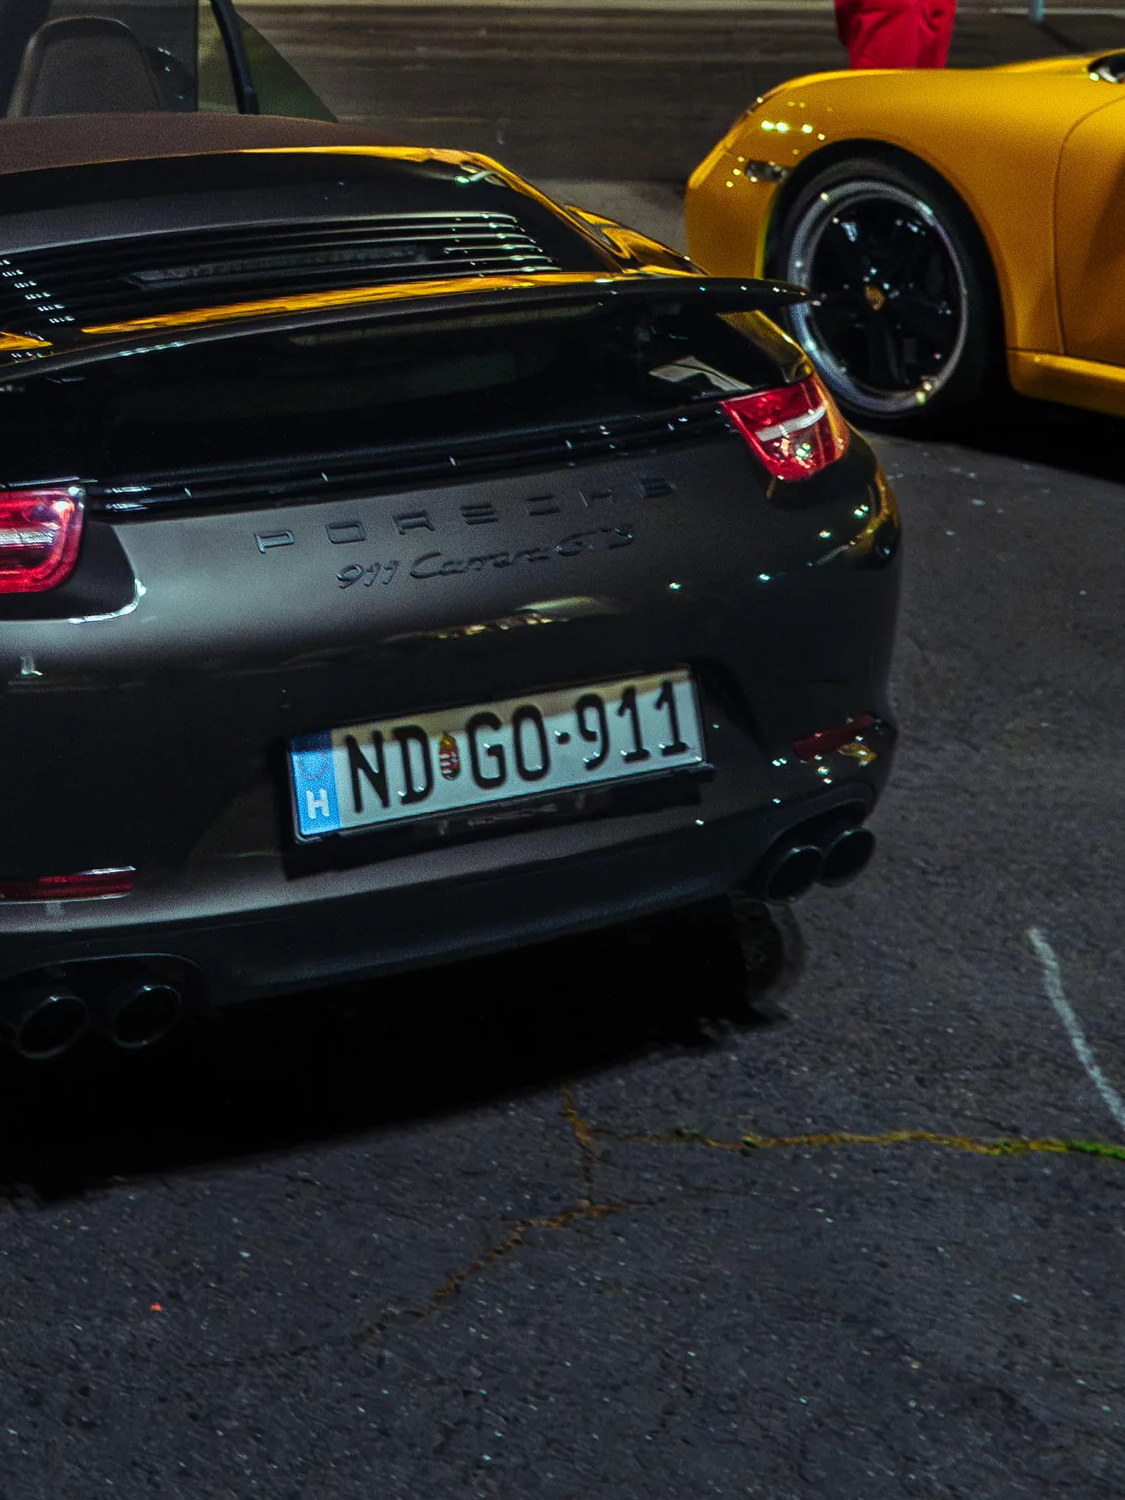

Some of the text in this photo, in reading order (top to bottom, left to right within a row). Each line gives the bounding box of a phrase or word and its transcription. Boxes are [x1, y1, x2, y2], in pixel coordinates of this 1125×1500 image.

[253, 475, 675, 554] PORSCHE
[336, 559, 400, 589] 911
[305, 787, 330, 820] H
